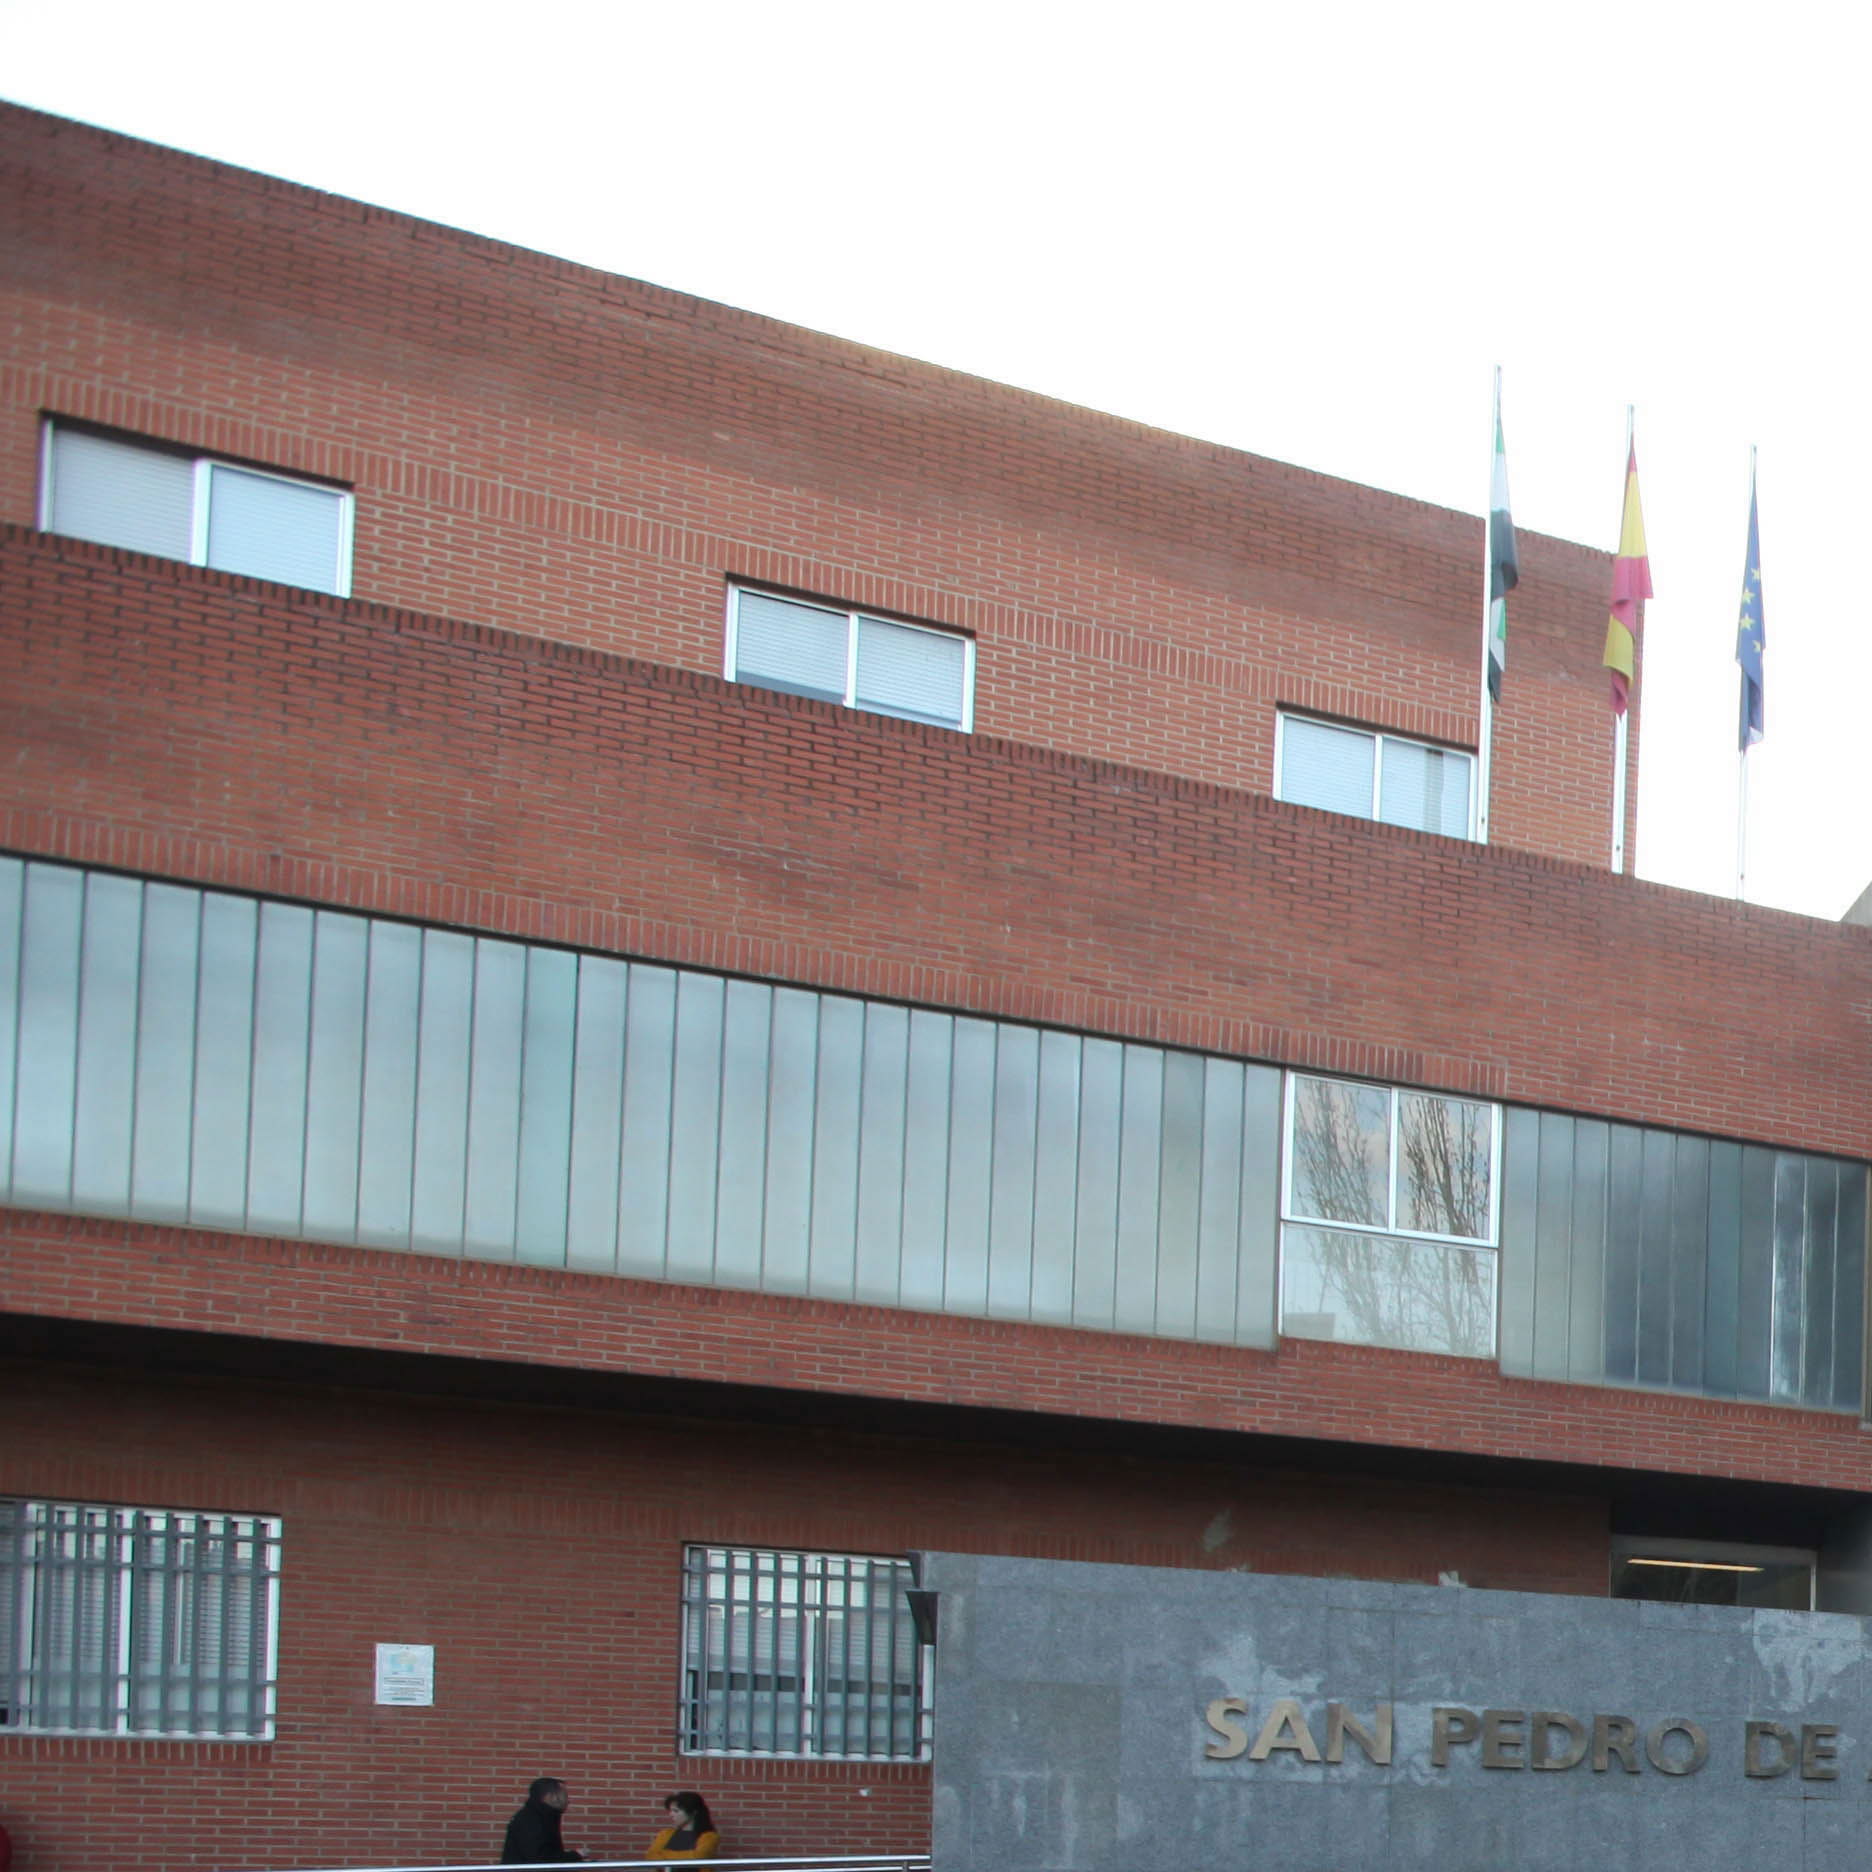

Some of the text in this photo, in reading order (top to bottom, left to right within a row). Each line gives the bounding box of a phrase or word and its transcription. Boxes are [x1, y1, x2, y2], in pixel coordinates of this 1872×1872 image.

[1205, 1697, 1393, 1765] SAN
[1430, 1705, 1710, 1776] PEDRO
[1744, 1720, 1839, 1782] DE
